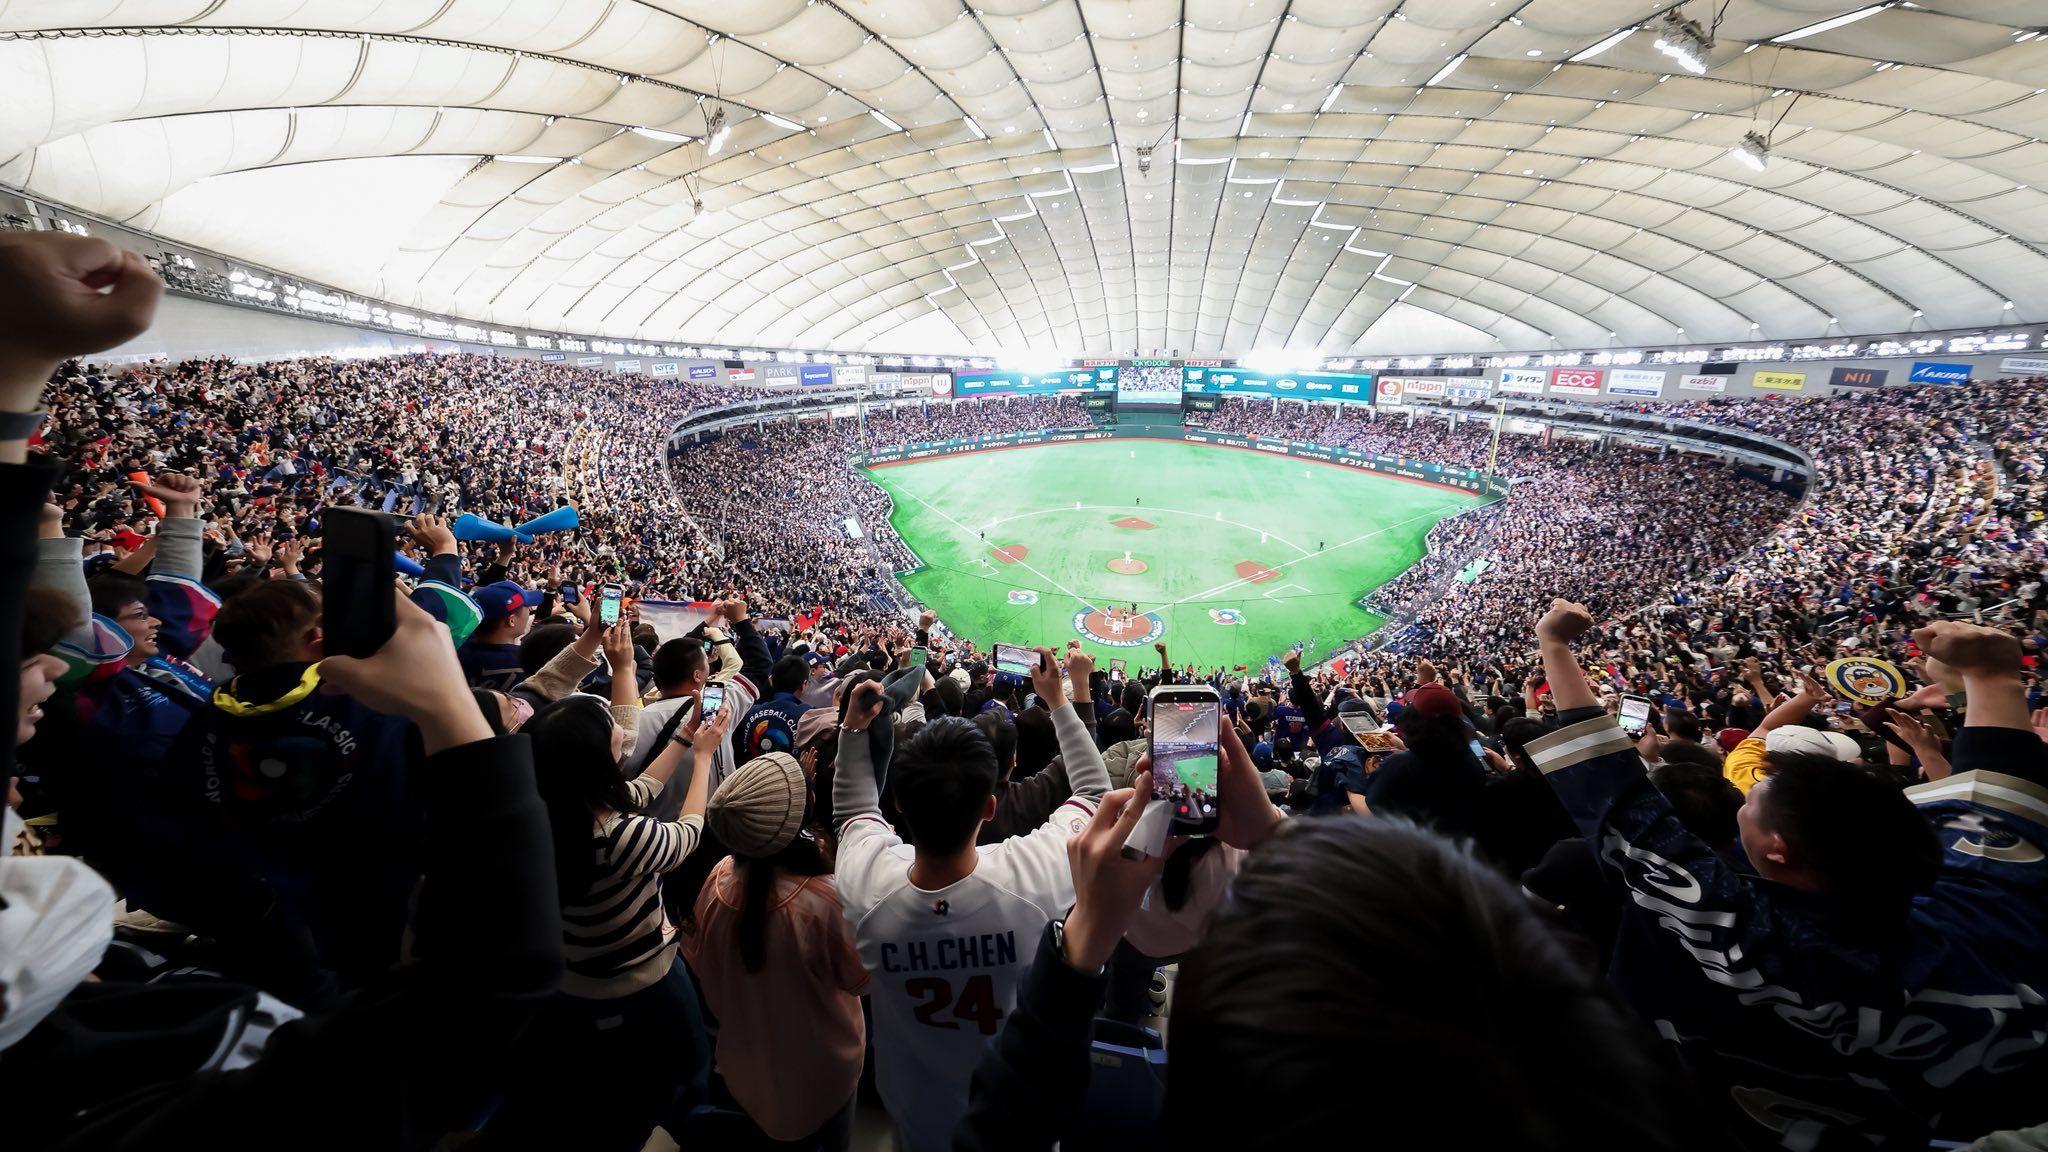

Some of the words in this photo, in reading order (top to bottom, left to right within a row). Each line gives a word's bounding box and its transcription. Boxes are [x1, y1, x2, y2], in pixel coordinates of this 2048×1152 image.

[767, 368, 794, 377] PARK
[903, 377, 929, 386] nippn
[1407, 381, 1442, 392] nippn
[1557, 374, 1595, 387] ECC
[1690, 377, 1717, 386] azbil
[1185, 434, 1206, 442] Canon
[1085, 633, 1141, 647] BASEBALL
[750, 709, 787, 722] BASEBALL
[881, 930, 1017, 973] C.H.CHEN
[905, 974, 1004, 1036] 24
